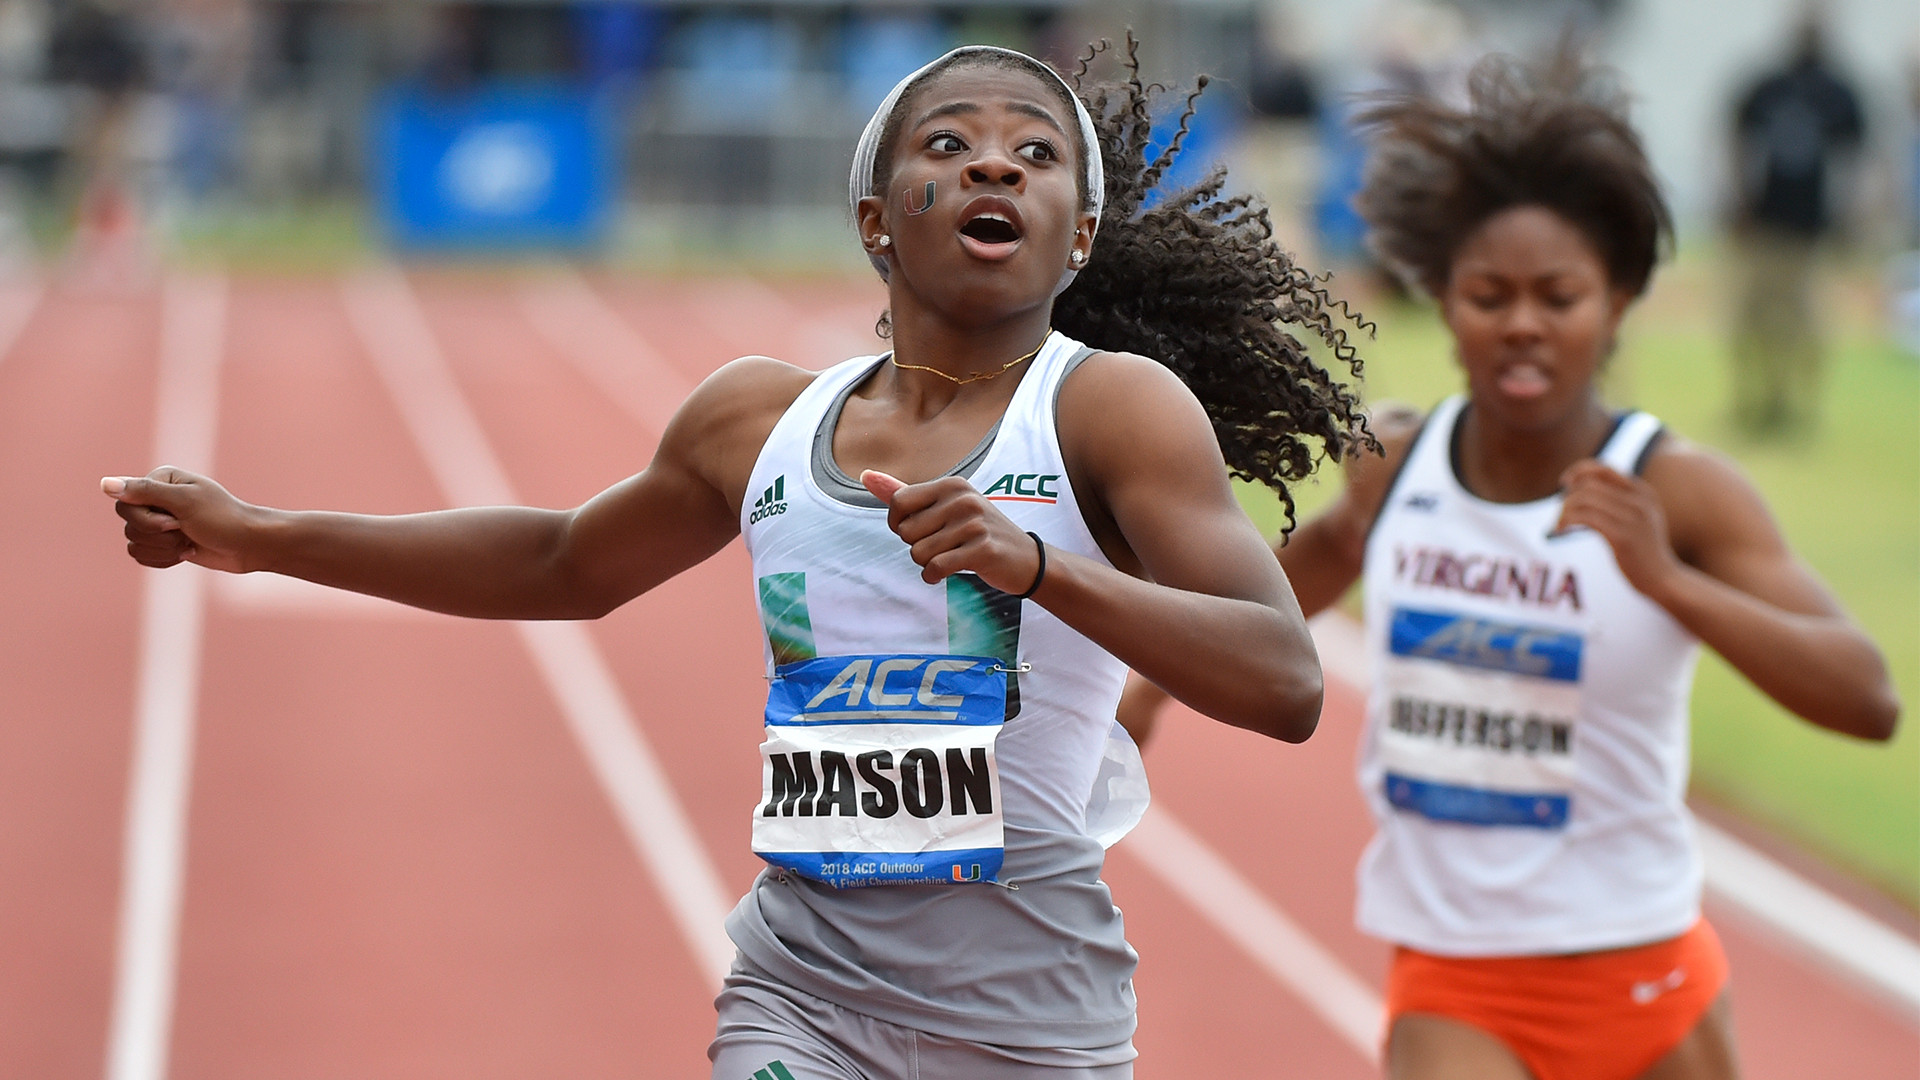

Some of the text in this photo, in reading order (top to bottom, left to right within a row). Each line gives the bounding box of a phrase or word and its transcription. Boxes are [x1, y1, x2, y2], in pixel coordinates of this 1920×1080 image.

[903, 181, 936, 216] U
[983, 474, 1061, 498] ACC
[750, 501, 788, 525] adidas
[805, 658, 977, 709] ACC
[763, 747, 993, 819] MASON
[821, 862, 925, 875] 2018 ACC Outdoor
[840, 877, 866, 888] Field
